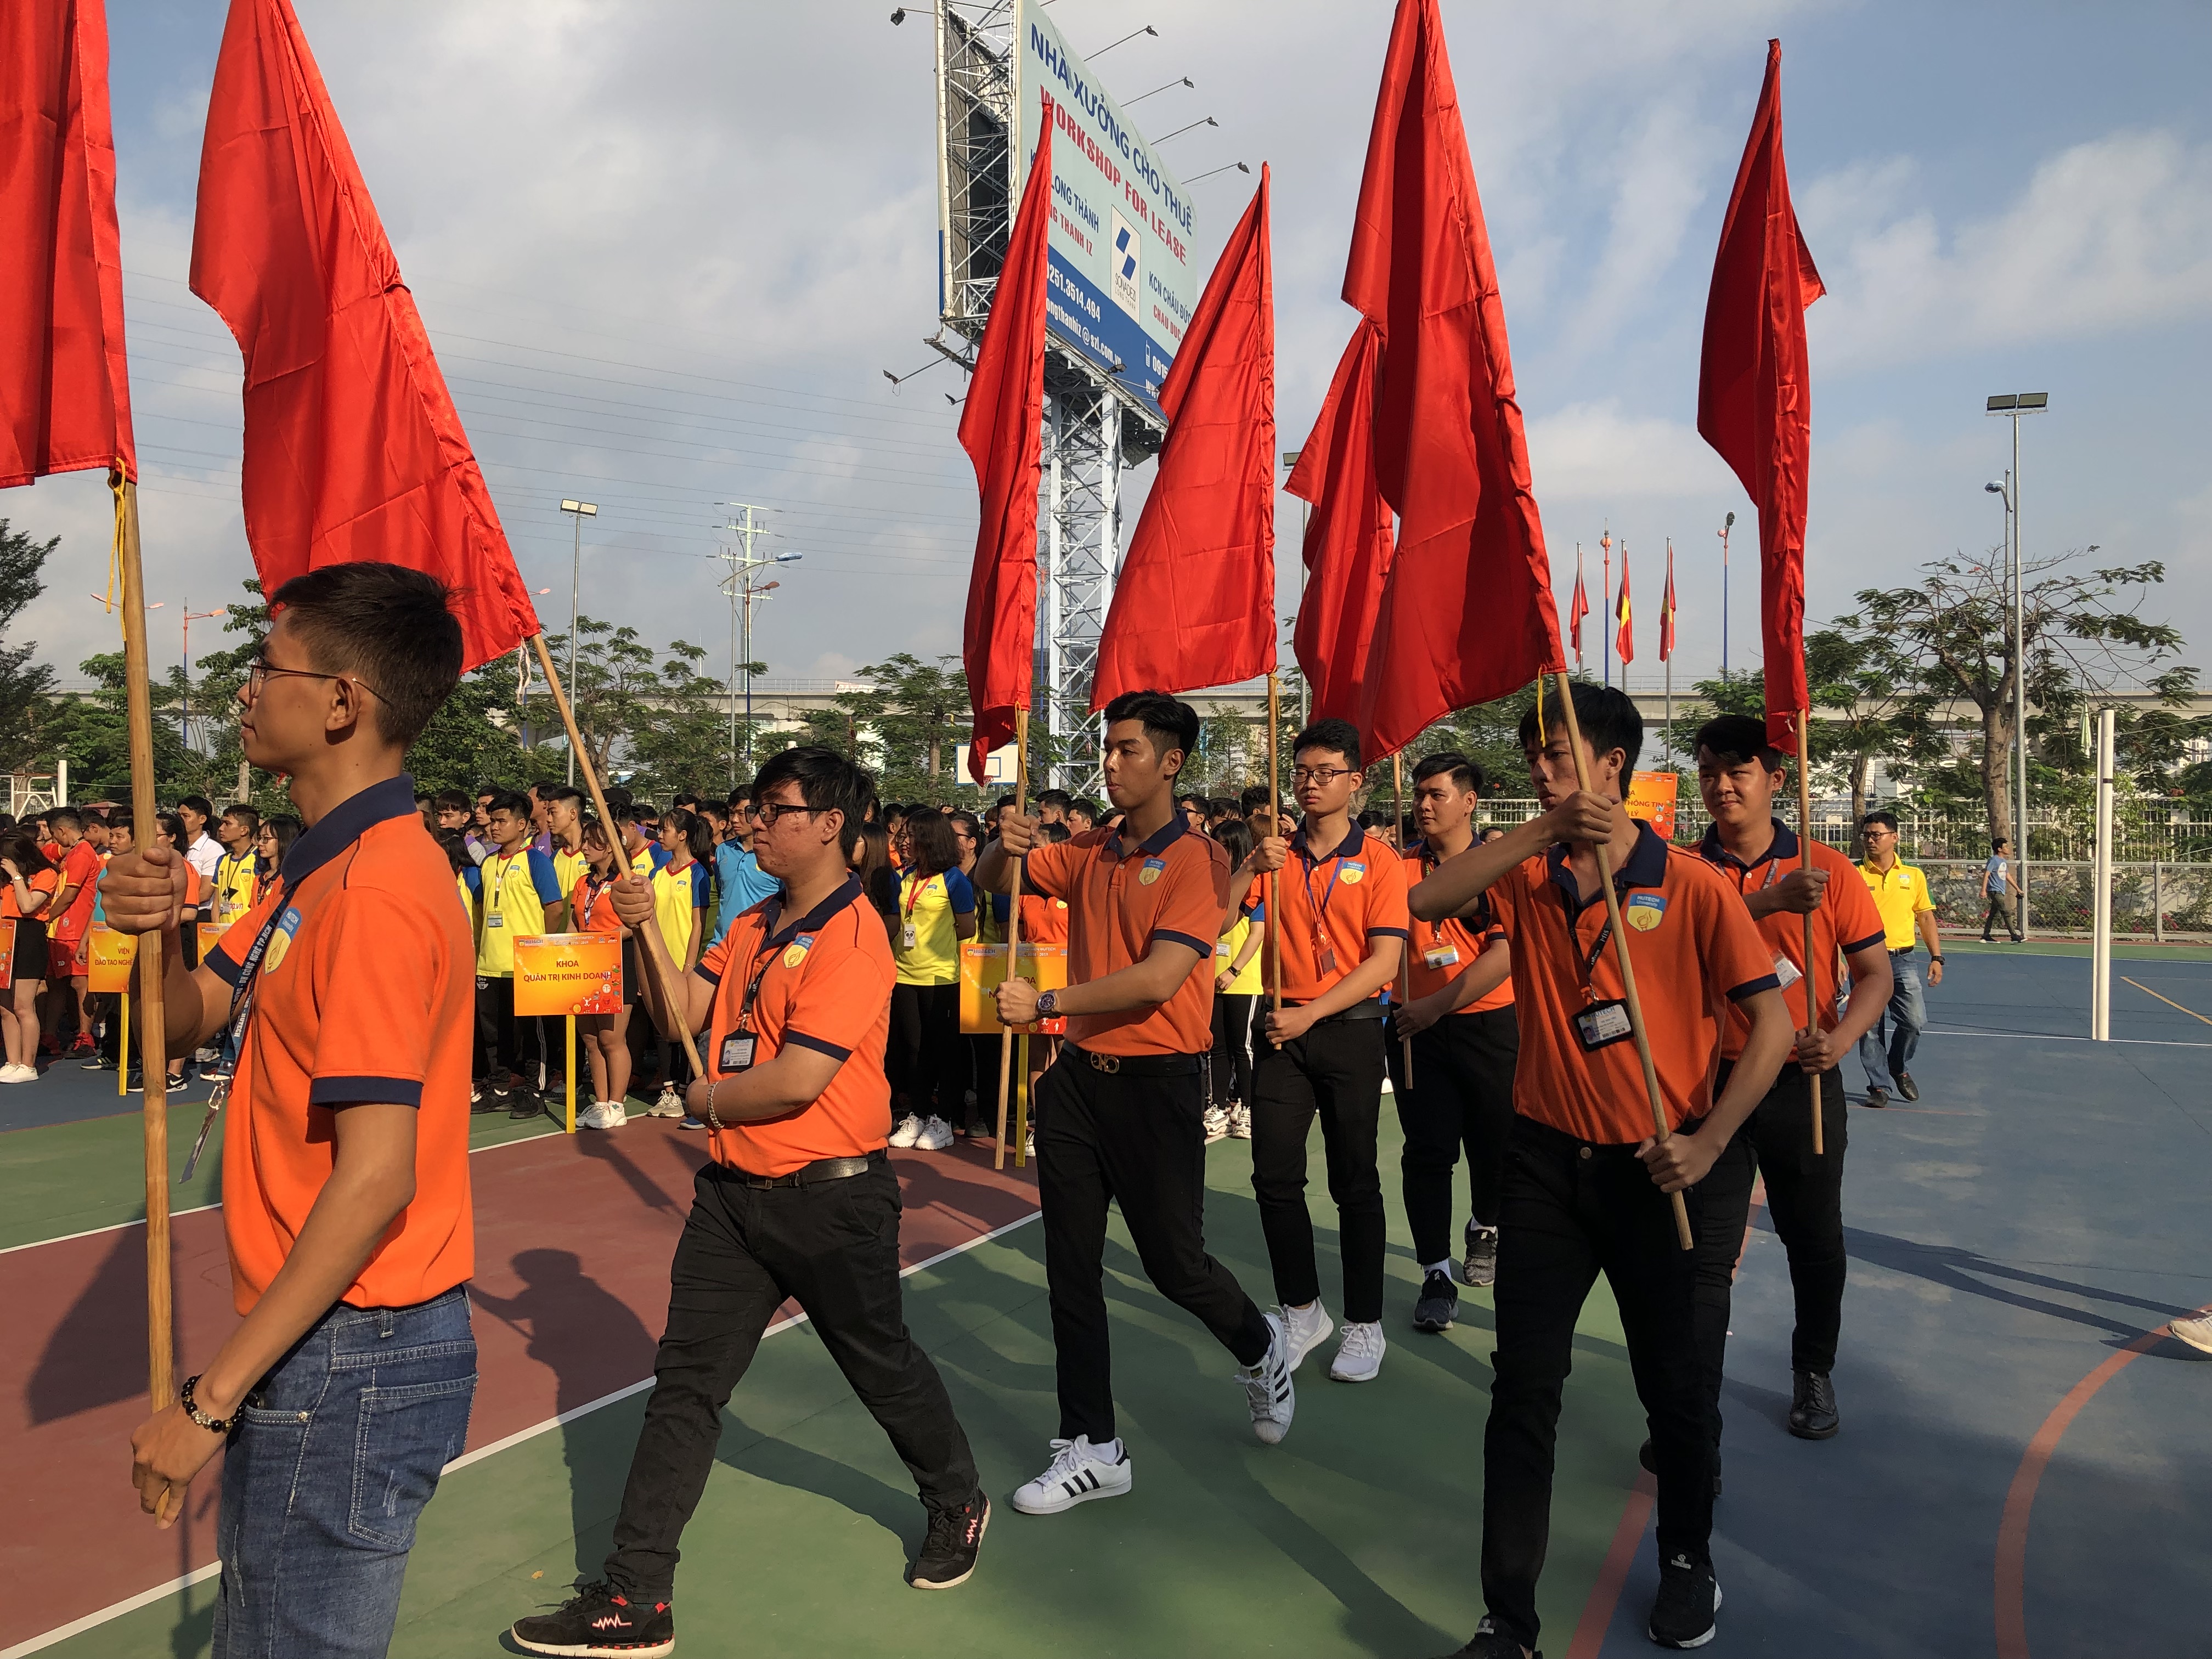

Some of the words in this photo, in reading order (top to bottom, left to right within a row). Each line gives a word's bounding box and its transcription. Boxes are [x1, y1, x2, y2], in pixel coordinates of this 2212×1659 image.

[1031, 22, 1070, 91] NHÀ
[1074, 72, 1129, 160] XƯỞNG
[1133, 148, 1160, 195] CHO
[1163, 180, 1192, 236] THUÊ
[1040, 84, 1120, 188] WORKSHOP
[1125, 179, 1147, 223] FOR
[1152, 211, 1186, 267] LEASE
[1074, 193, 1099, 233] THÀNH
[1060, 212, 1084, 249] THANH
[1086, 238, 1093, 257] IZ
[1115, 273, 1136, 302] SONADEZI
[1149, 271, 1161, 297] KCN
[1163, 286, 1179, 315] CHÂU
[1046, 297, 1121, 365] ongthanhiz@szl.com.vn
[1153, 304, 1169, 330] CHAU
[1170, 321, 1181, 342] DUC
[118, 946, 130, 955] VIỆN
[242, 960, 255, 977] CÔNG
[257, 924, 273, 947] TP.HCM
[523, 972, 546, 983] QUẢN
[548, 974, 560, 982] TRỊ
[583, 972, 612, 980] DOANH
[234, 1013, 246, 1037] HUTECH
